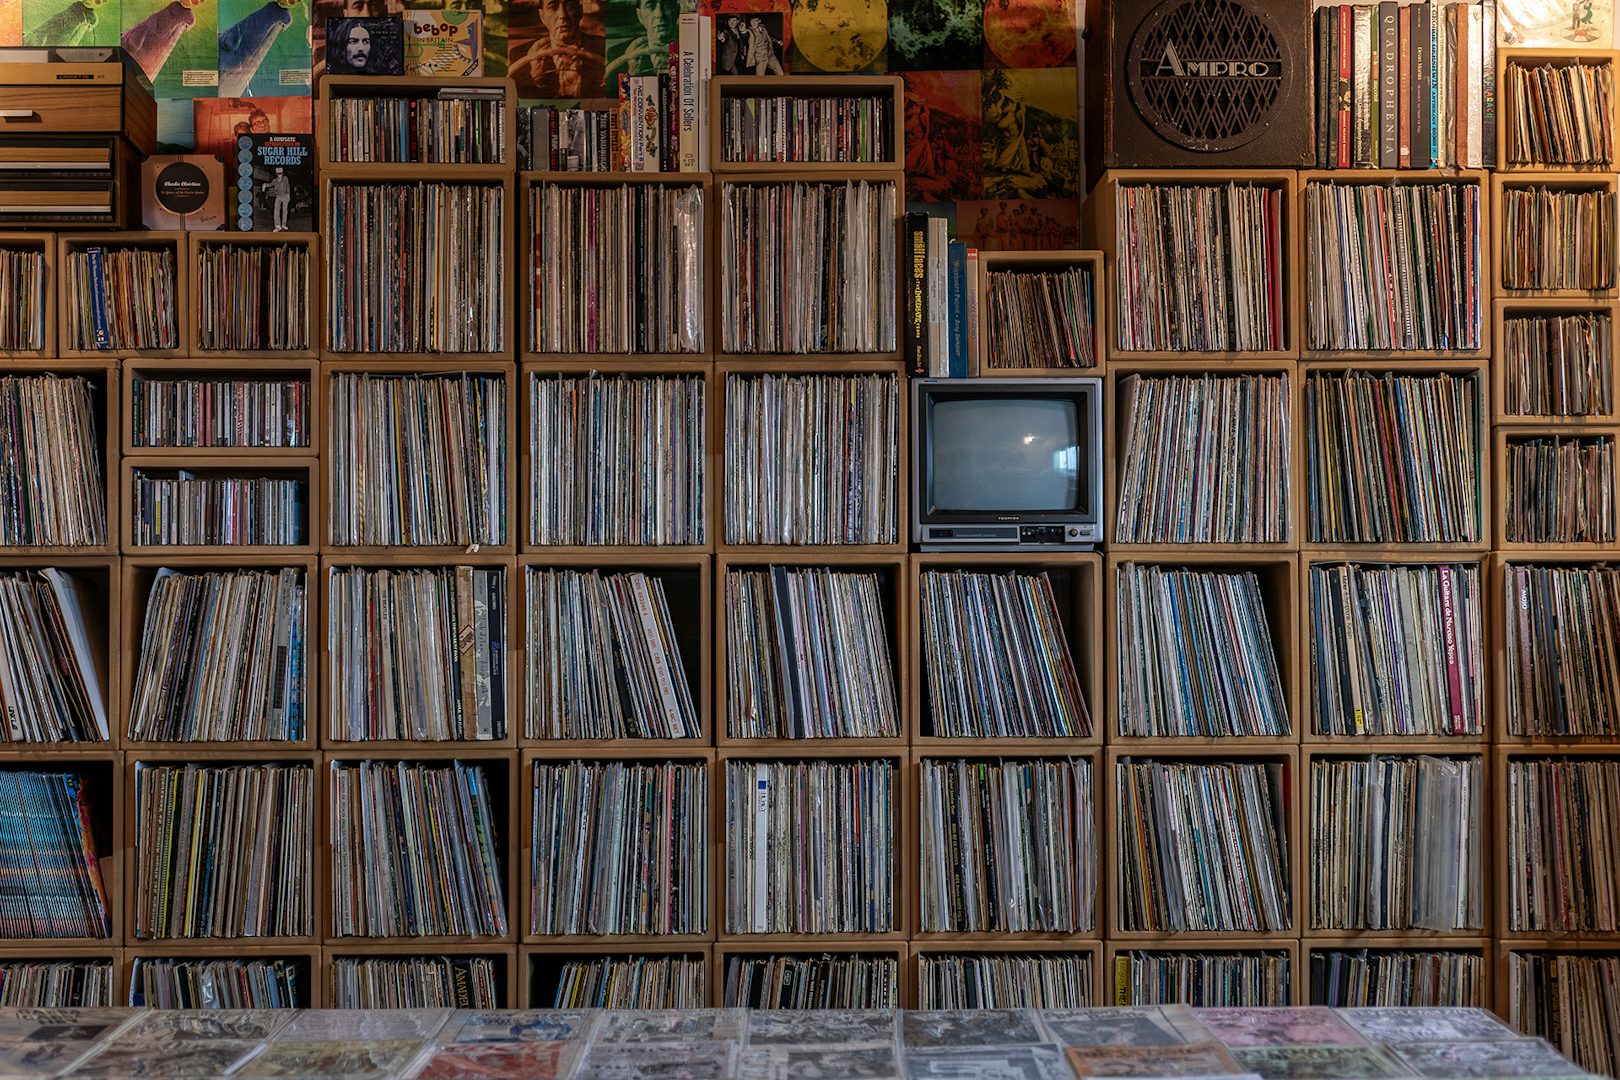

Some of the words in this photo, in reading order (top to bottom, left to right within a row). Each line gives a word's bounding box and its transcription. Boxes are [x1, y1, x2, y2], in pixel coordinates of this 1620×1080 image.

[414, 23, 458, 37] bebop
[1155, 38, 1269, 76] AMPRO
[683, 58, 694, 96] Celebration
[1383, 15, 1395, 154] QUADROPHENIA
[683, 98, 694, 107] Of
[599, 112, 608, 129] THE
[683, 108, 694, 132] Sellers
[257, 146, 285, 157] SUGAR
[286, 146, 309, 157] HILL
[264, 156, 302, 166] RECORDS
[599, 129, 608, 172] YARDBIRDS
[913, 230, 926, 255] small
[913, 255, 926, 279] faces
[914, 290, 922, 323] IMMEDIATE
[634, 578, 642, 591] CBS
[1441, 569, 1449, 581] La
[1442, 580, 1451, 608] Guitare
[1520, 589, 1528, 610] MOJO
[1445, 607, 1452, 617] de
[478, 617, 486, 631] bob
[1446, 617, 1454, 645] Narciso
[478, 631, 487, 652] dylan
[653, 652, 661, 665] CBS
[1446, 644, 1455, 665] Yepes
[478, 660, 488, 695] biograph
[672, 723, 680, 735] SET
[157, 773, 165, 813] Venezuela
[455, 967, 469, 1009] AMADEU
[1119, 986, 1127, 1002] THE
